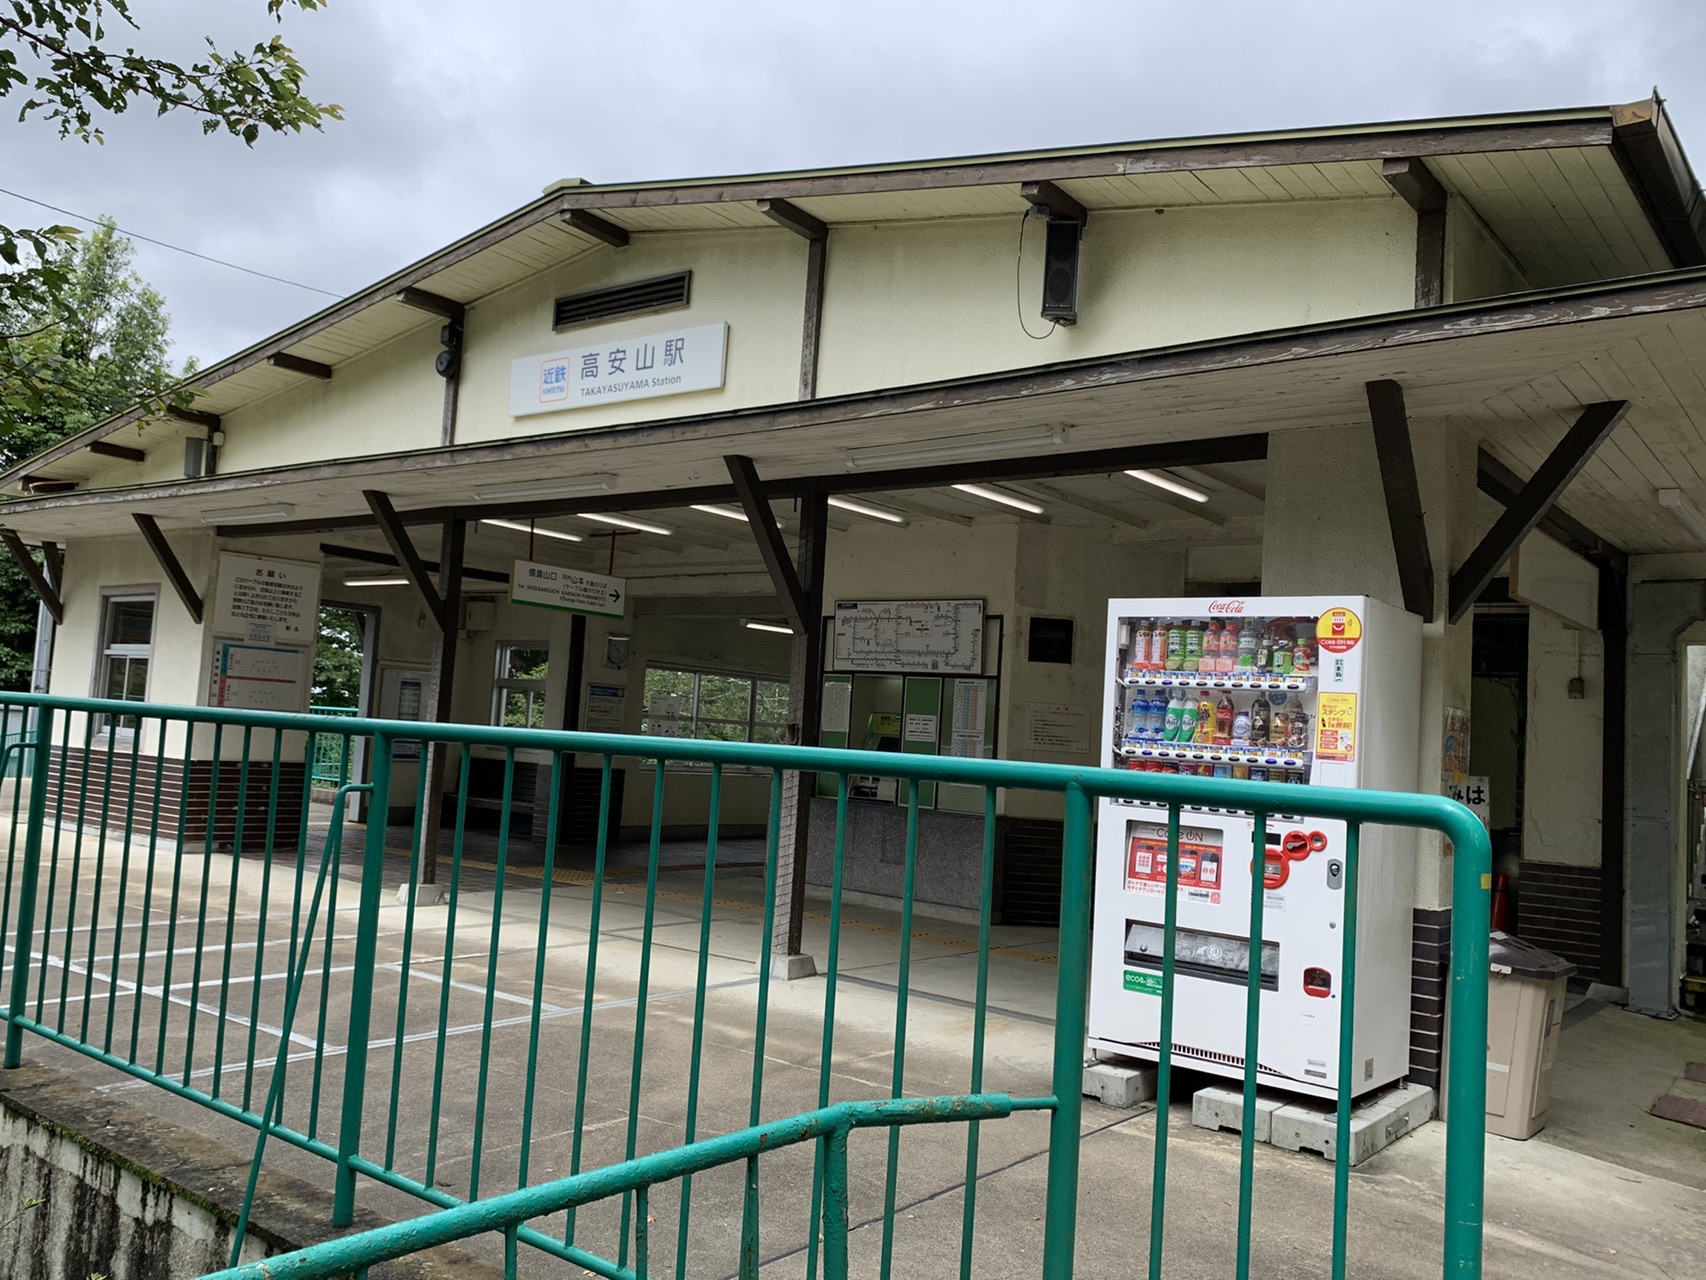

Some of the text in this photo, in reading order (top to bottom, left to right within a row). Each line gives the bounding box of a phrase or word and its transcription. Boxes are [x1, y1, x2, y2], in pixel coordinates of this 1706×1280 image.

[580, 337, 686, 380] 高安山駅
[543, 365, 567, 385] 近鉄
[542, 385, 566, 396] KINTETSU
[580, 374, 682, 397] TAKAYASUYAMA Station
[528, 568, 558, 581] 信貴山口
[1186, 830, 1204, 842] ON
